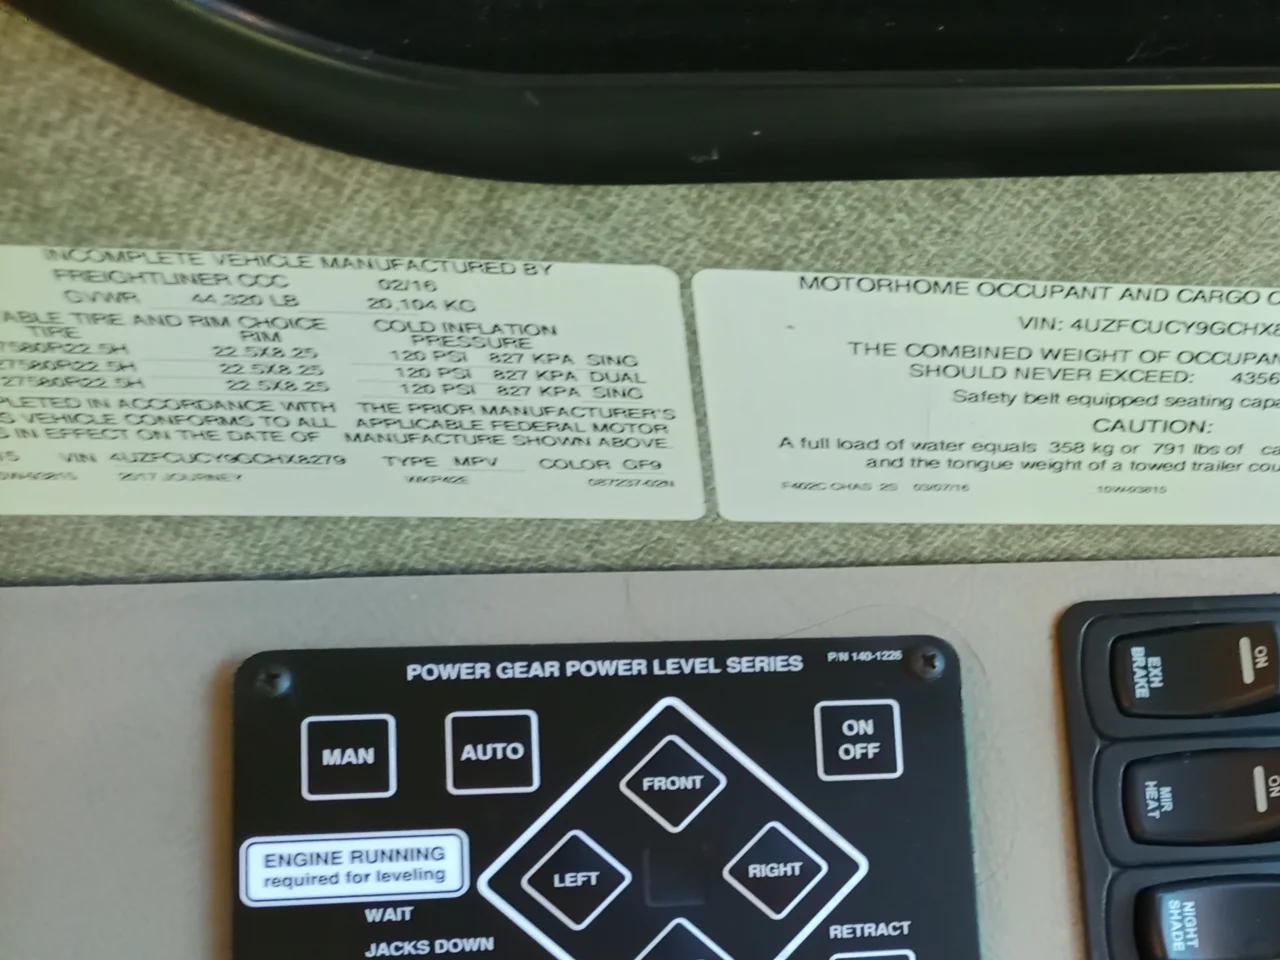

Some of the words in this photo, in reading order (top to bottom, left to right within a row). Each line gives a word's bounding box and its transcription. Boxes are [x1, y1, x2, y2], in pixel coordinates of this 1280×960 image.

[214, 254, 313, 268] VEHICLE
[320, 256, 517, 274] MANUFACTURED
[523, 262, 553, 275] BY
[52, 269, 232, 285] FREIGHTLINER
[378, 278, 438, 291] 02/16
[799, 276, 969, 295] MOTORHOME
[977, 282, 1113, 300] OCCUPANT
[1120, 286, 1170, 301] AND
[1177, 288, 1261, 304] CARGO
[133, 314, 183, 327] AND
[237, 316, 328, 330] CHOICE
[373, 319, 436, 333] COLD
[442, 322, 558, 336] INFLATION
[1018, 316, 1064, 330] VIN:
[411, 335, 534, 349] PRESSURE
[848, 342, 897, 355] THE
[905, 343, 1033, 360] COMBINED
[1040, 347, 1133, 362] WEIGHT
[1139, 350, 1170, 363] OF
[536, 370, 578, 381] KPA
[590, 371, 647, 383] DUAL
[909, 363, 1006, 379] SHOULD
[1014, 367, 1092, 381] NEVER
[1099, 368, 1194, 384] EXCEED:
[1231, 372, 1280, 385] 4356
[539, 386, 581, 398] KPA
[952, 389, 1017, 405] Safety
[1024, 391, 1059, 404] belt
[1066, 393, 1158, 407] equipped
[1164, 395, 1233, 409] seating
[118, 398, 277, 411] ACCORDANCE
[281, 400, 337, 413] WITH
[358, 402, 402, 414] THE
[408, 404, 475, 416] PRIOR
[481, 405, 676, 419] MANUFACTURER'S
[22, 412, 117, 424] VEHICLE
[124, 413, 255, 427] CONFORMS
[259, 416, 291, 427] TO
[298, 416, 338, 428] ALL
[356, 418, 485, 430] APPLICABLE
[492, 420, 586, 432] FEDERAL
[593, 422, 669, 434] MOTOR
[1092, 418, 1213, 433] CAUTION:
[45, 428, 128, 439] EFFECT
[226, 432, 283, 442] DATE
[345, 433, 506, 446] MANUFACTURE
[512, 435, 590, 447] SHOWN
[800, 437, 830, 449] full
[836, 438, 880, 450] load
[911, 441, 965, 451] water
[971, 440, 1037, 453] equals
[1048, 441, 1085, 453] 358
[1091, 441, 1114, 456] kg
[1152, 442, 1186, 454] 791
[1193, 443, 1220, 455] lbs
[383, 455, 439, 467] TYPE
[539, 458, 611, 470] COLOR
[865, 457, 904, 469] and
[909, 457, 941, 469] the
[946, 459, 1015, 473] tongue
[1020, 458, 1082, 473] weight
[1087, 459, 1108, 471] of
[1129, 460, 1186, 472] towed
[1191, 460, 1243, 472] trailer
[827, 651, 849, 662] P/N
[1254, 645, 1269, 669] ON
[406, 663, 491, 681] POWER
[496, 661, 560, 679] GEAR
[565, 659, 648, 677] POWER
[653, 657, 721, 675] LEVEL
[726, 655, 804, 673] SERIES
[1130, 646, 1150, 699] BRAKE
[1147, 656, 1163, 688] EXH
[842, 719, 874, 736] ON
[322, 747, 375, 766] MAN
[460, 742, 524, 761] AUTO
[838, 743, 880, 760] OFF
[643, 775, 704, 791] FRONT
[1144, 780, 1160, 819] HEAT
[1159, 786, 1173, 812] MIR
[264, 850, 343, 869] ENGINE
[350, 846, 445, 865] RUNNING
[263, 869, 340, 890] required
[345, 871, 371, 885] for
[376, 867, 446, 884] leveling
[553, 871, 600, 888] LEFT
[748, 861, 803, 879] RIGHT
[364, 906, 414, 923] WAIT
[829, 921, 912, 939] RETRACT
[1168, 900, 1185, 951] SHADE
[1182, 901, 1199, 948] NIGHT
[364, 940, 430, 958] JACKS
[434, 936, 495, 954] DOWN
